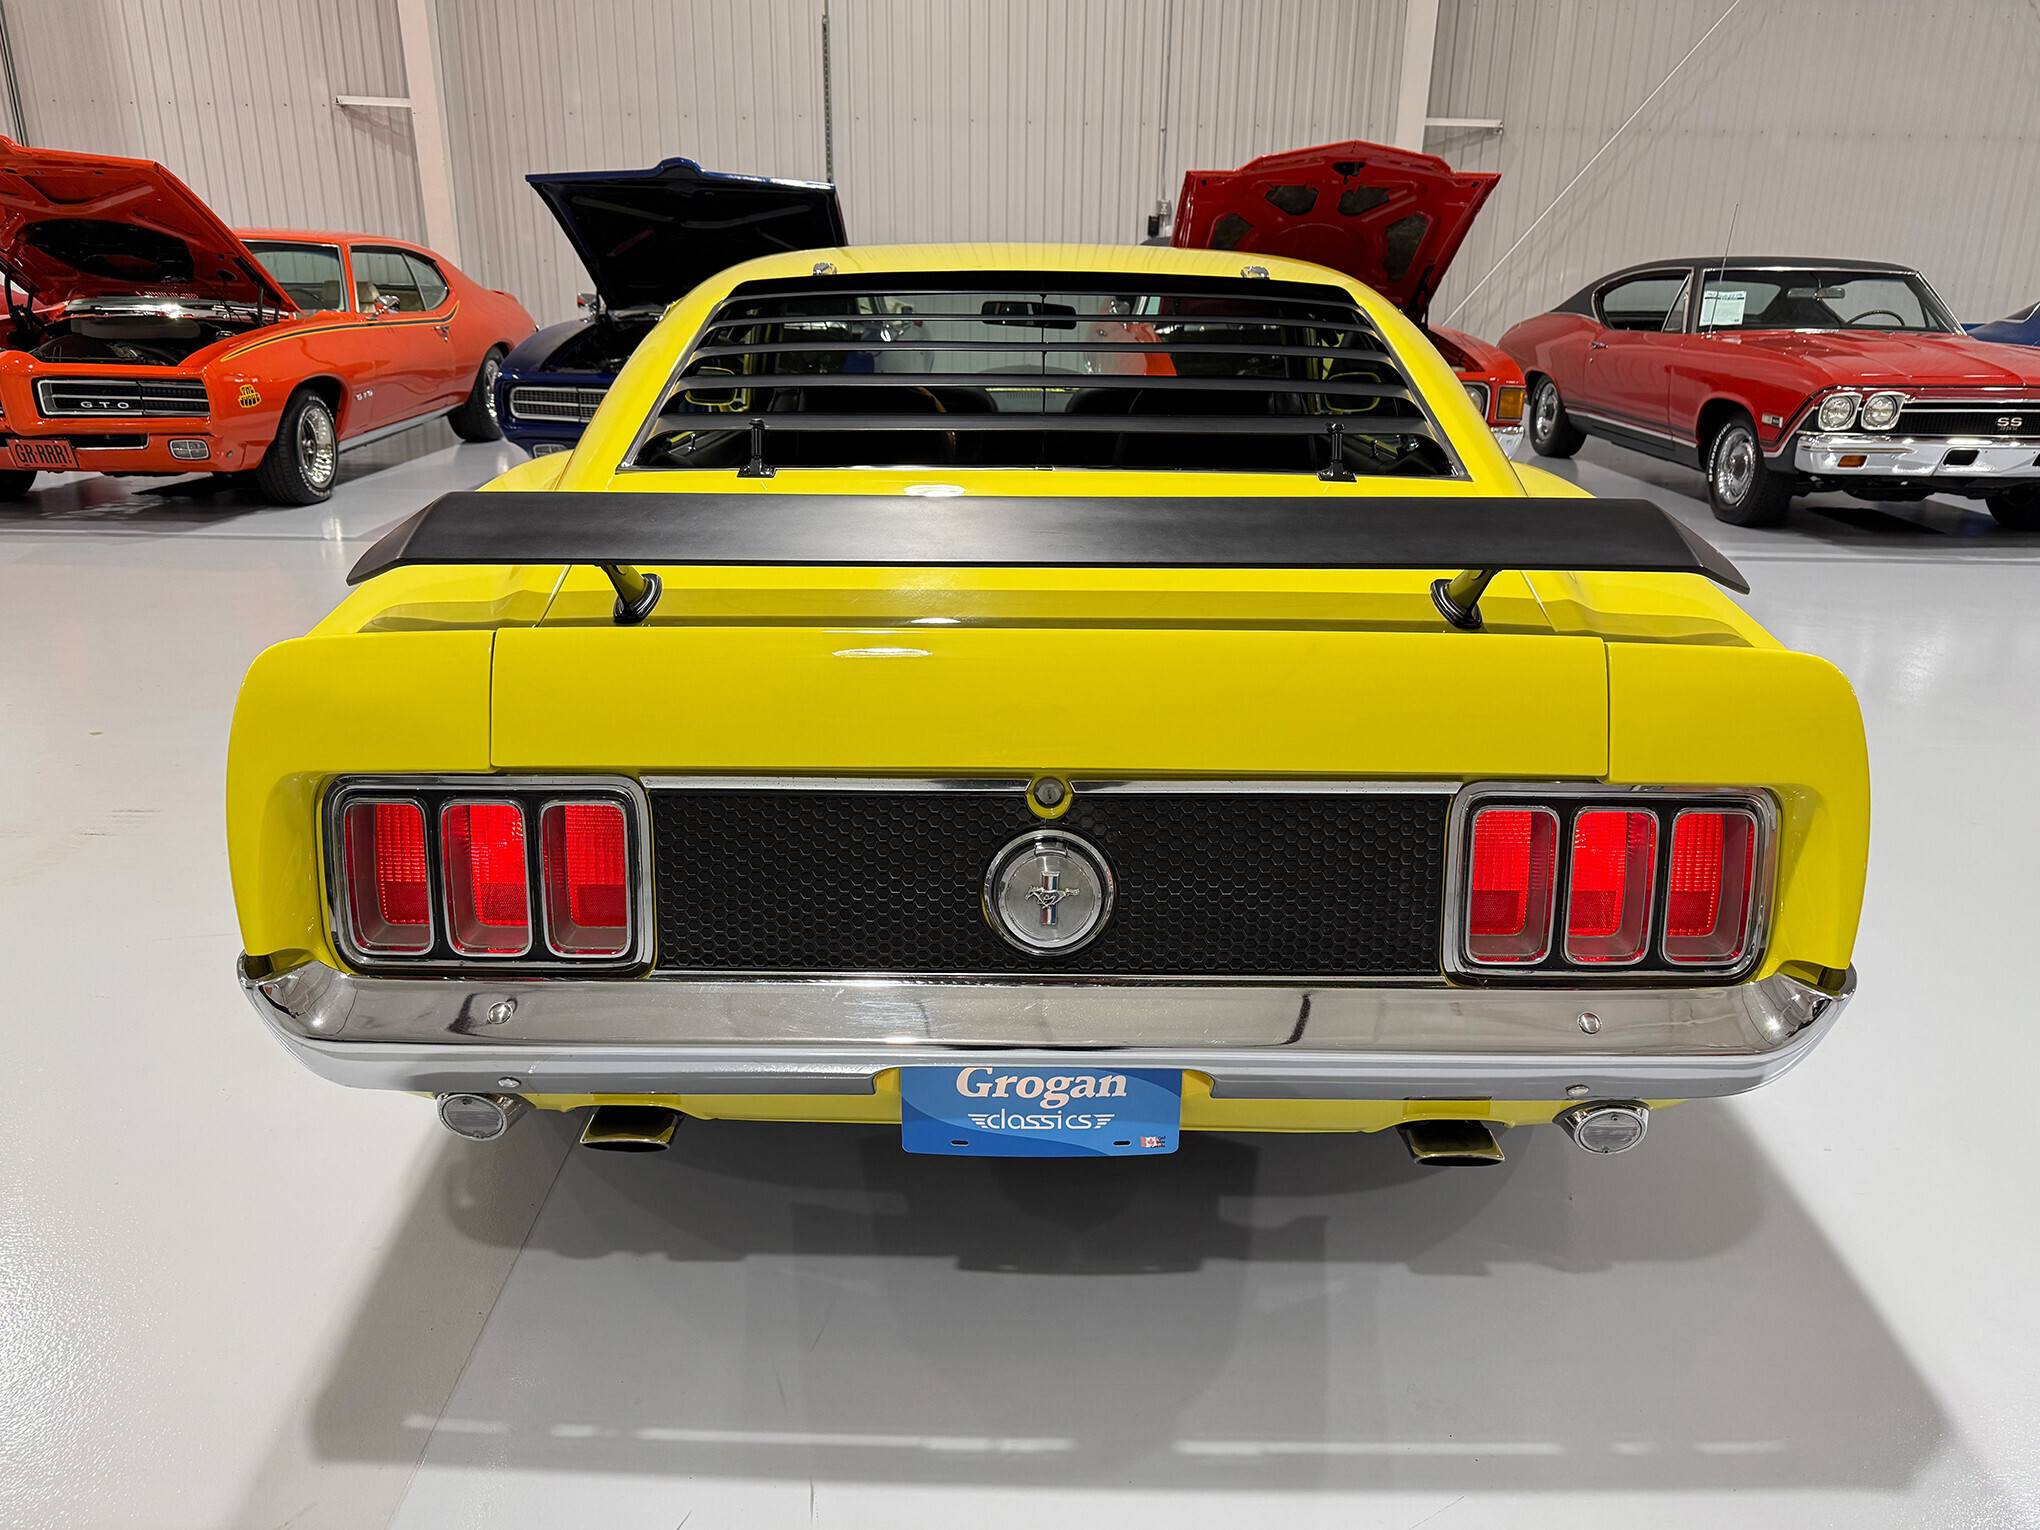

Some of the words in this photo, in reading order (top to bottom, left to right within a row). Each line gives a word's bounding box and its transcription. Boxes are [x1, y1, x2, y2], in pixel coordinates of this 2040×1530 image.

[80, 401, 130, 410] GTO
[1997, 417, 2023, 427] SS
[955, 1066, 1127, 1109] Grogan
[986, 1109, 1092, 1130] classics
